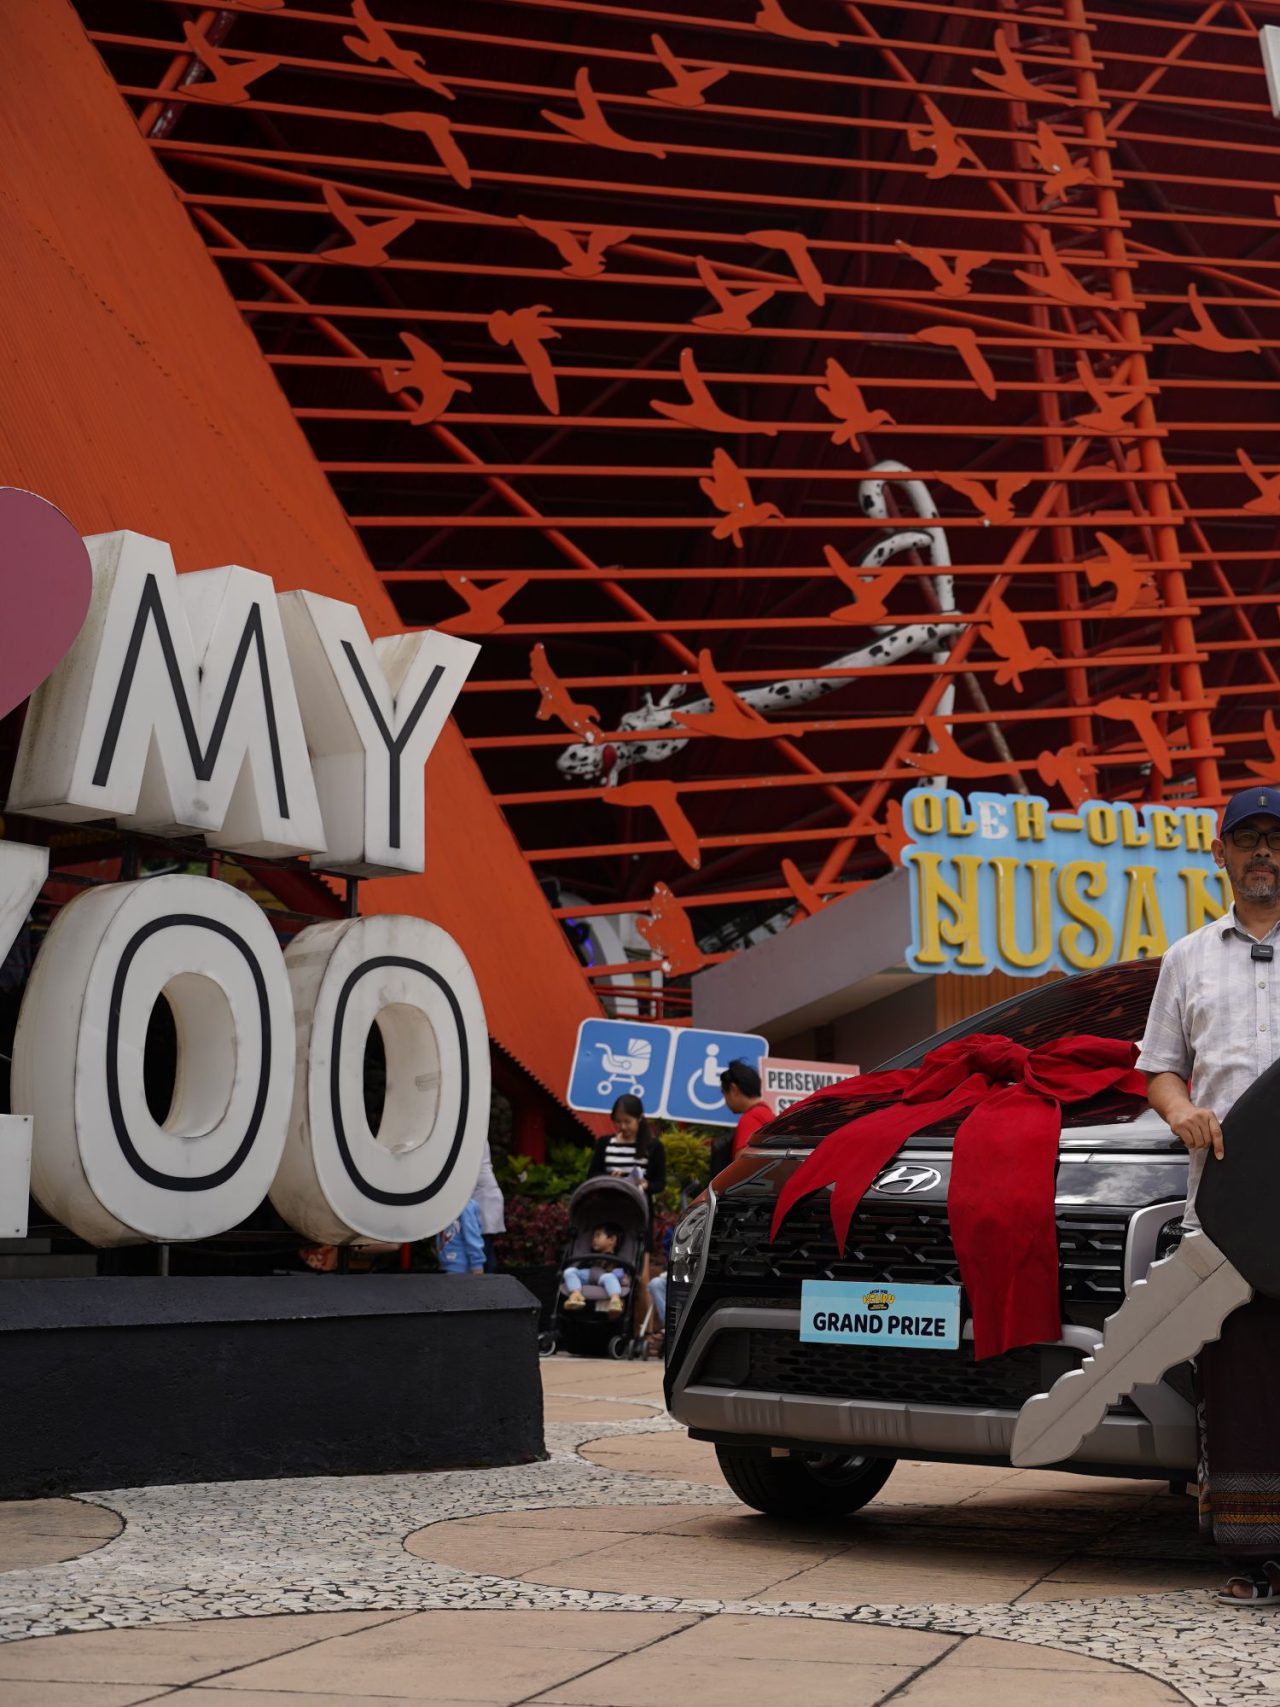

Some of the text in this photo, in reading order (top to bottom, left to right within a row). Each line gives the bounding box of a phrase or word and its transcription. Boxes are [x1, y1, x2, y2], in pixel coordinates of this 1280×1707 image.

[10, 530, 482, 876] MY
[911, 793, 1213, 852] OLEH-OLEH
[0, 841, 491, 1248] OO
[767, 1070, 853, 1093] PERSEWA
[813, 1312, 946, 1337] GRAND PRIZE
